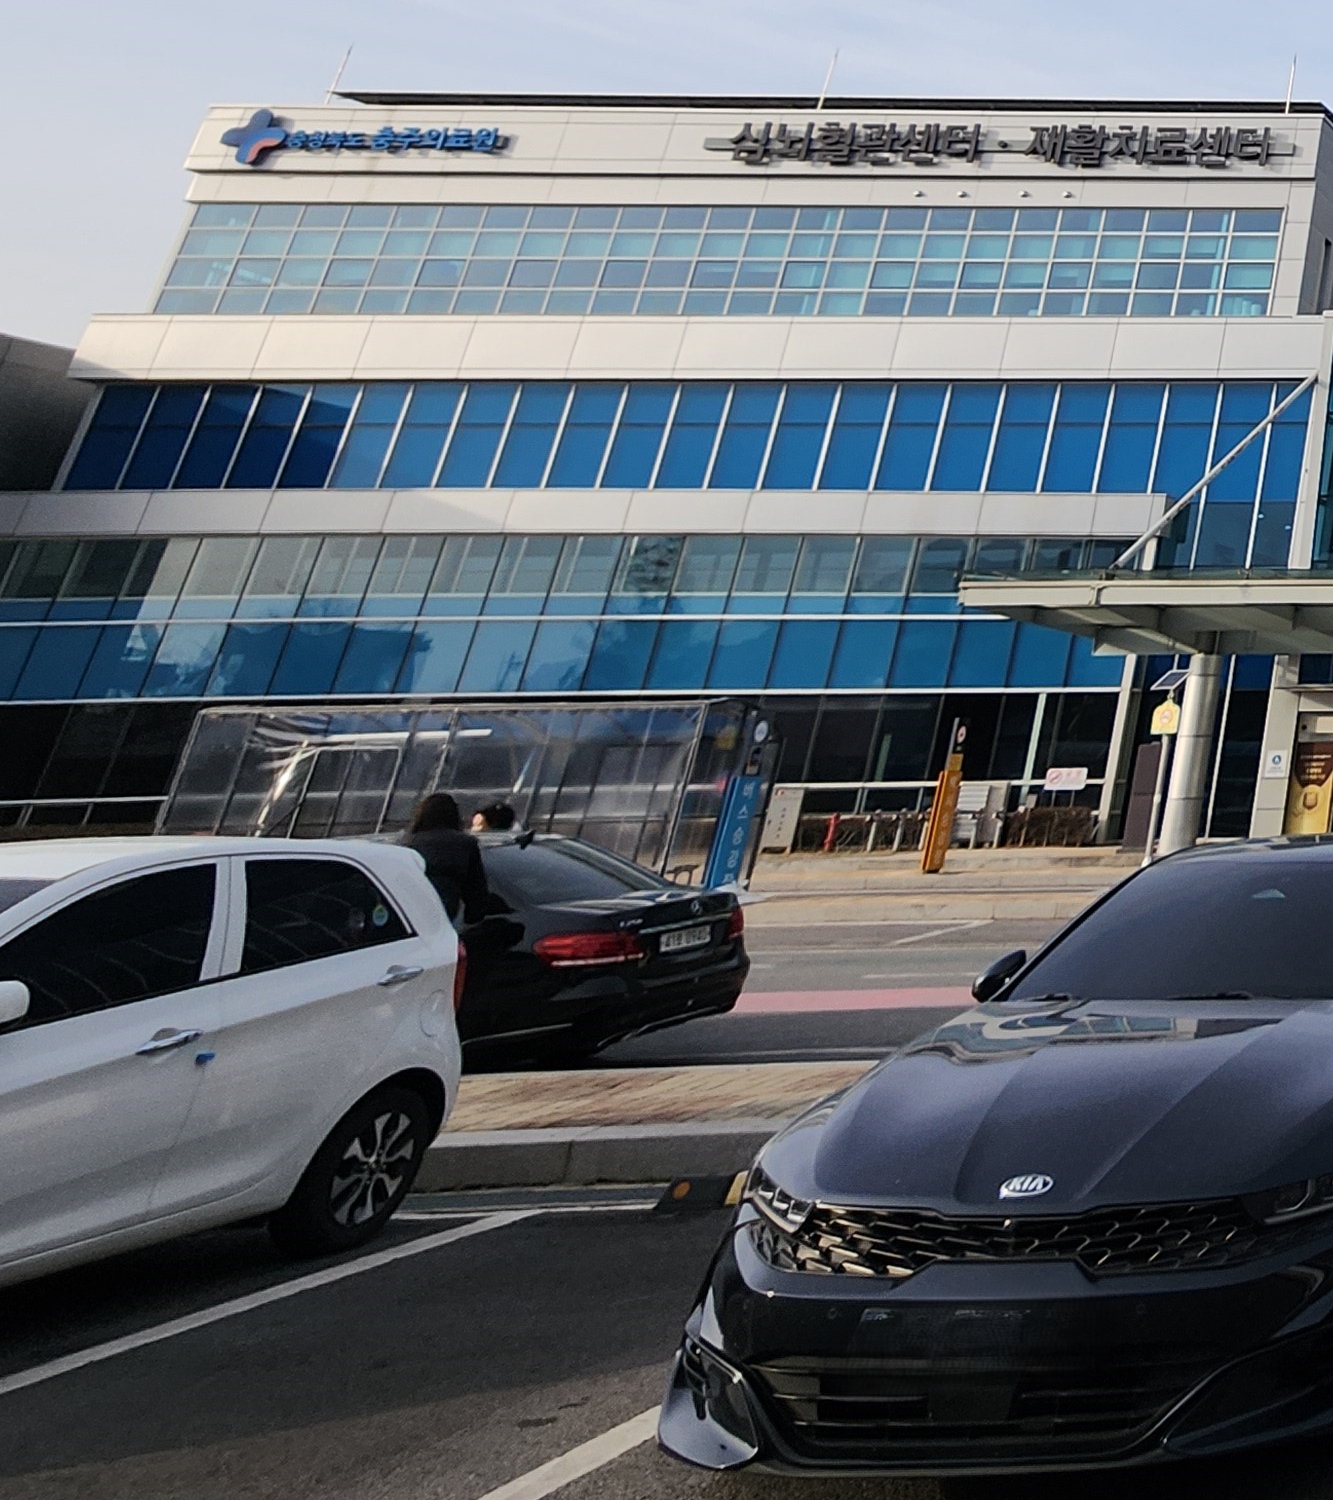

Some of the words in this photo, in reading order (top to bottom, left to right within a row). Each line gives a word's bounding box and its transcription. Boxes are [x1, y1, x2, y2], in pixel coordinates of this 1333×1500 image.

[371, 126, 499, 150] 충주의료원
[731, 121, 984, 166] 심뇌혈관센터
[1026, 123, 1276, 167] 재활치료센터
[1007, 1174, 1048, 1193] KIA
